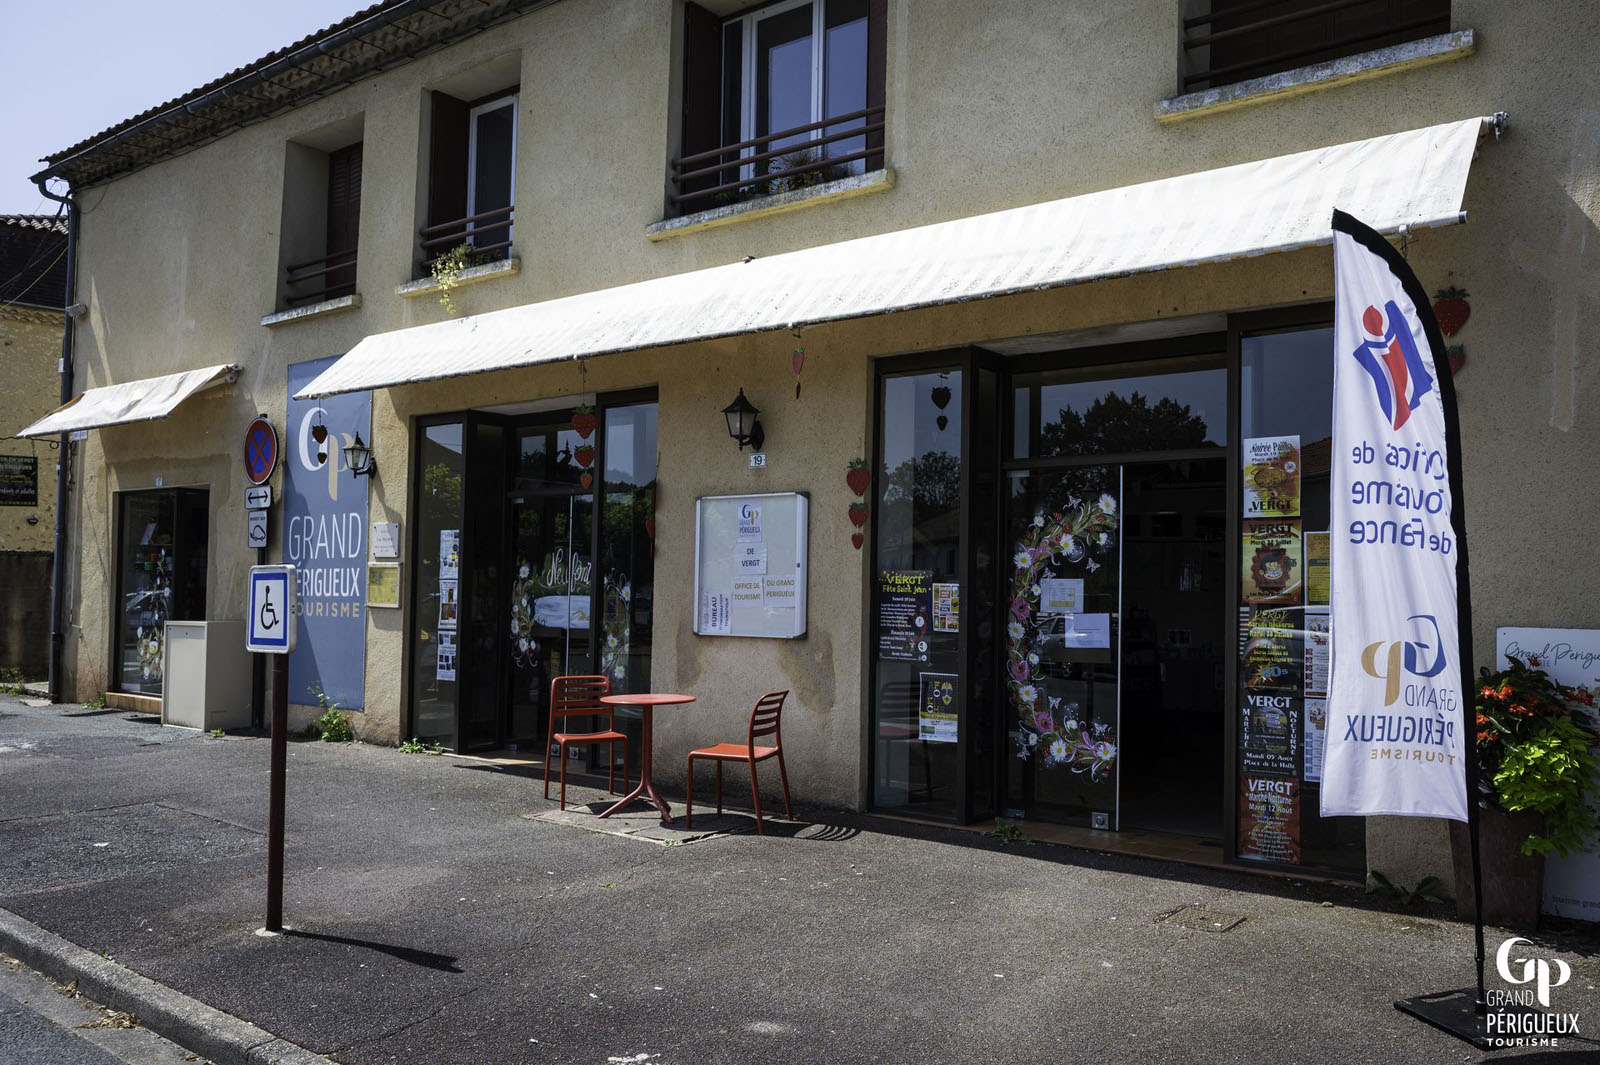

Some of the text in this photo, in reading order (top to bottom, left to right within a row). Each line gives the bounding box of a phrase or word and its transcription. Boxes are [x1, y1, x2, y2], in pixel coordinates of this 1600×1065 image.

[753, 455, 763, 466] 19
[1252, 500, 1291, 510] VERGT
[1250, 524, 1293, 533] VERGT
[289, 513, 362, 560] GRAND
[296, 561, 360, 597] ÉRIGUEUX
[297, 602, 360, 617] OURISME
[1505, 641, 1550, 659] Grand
[1247, 695, 1292, 708] VERGT
[1248, 779, 1293, 795] VERGT
[1248, 803, 1266, 811] Mardi
